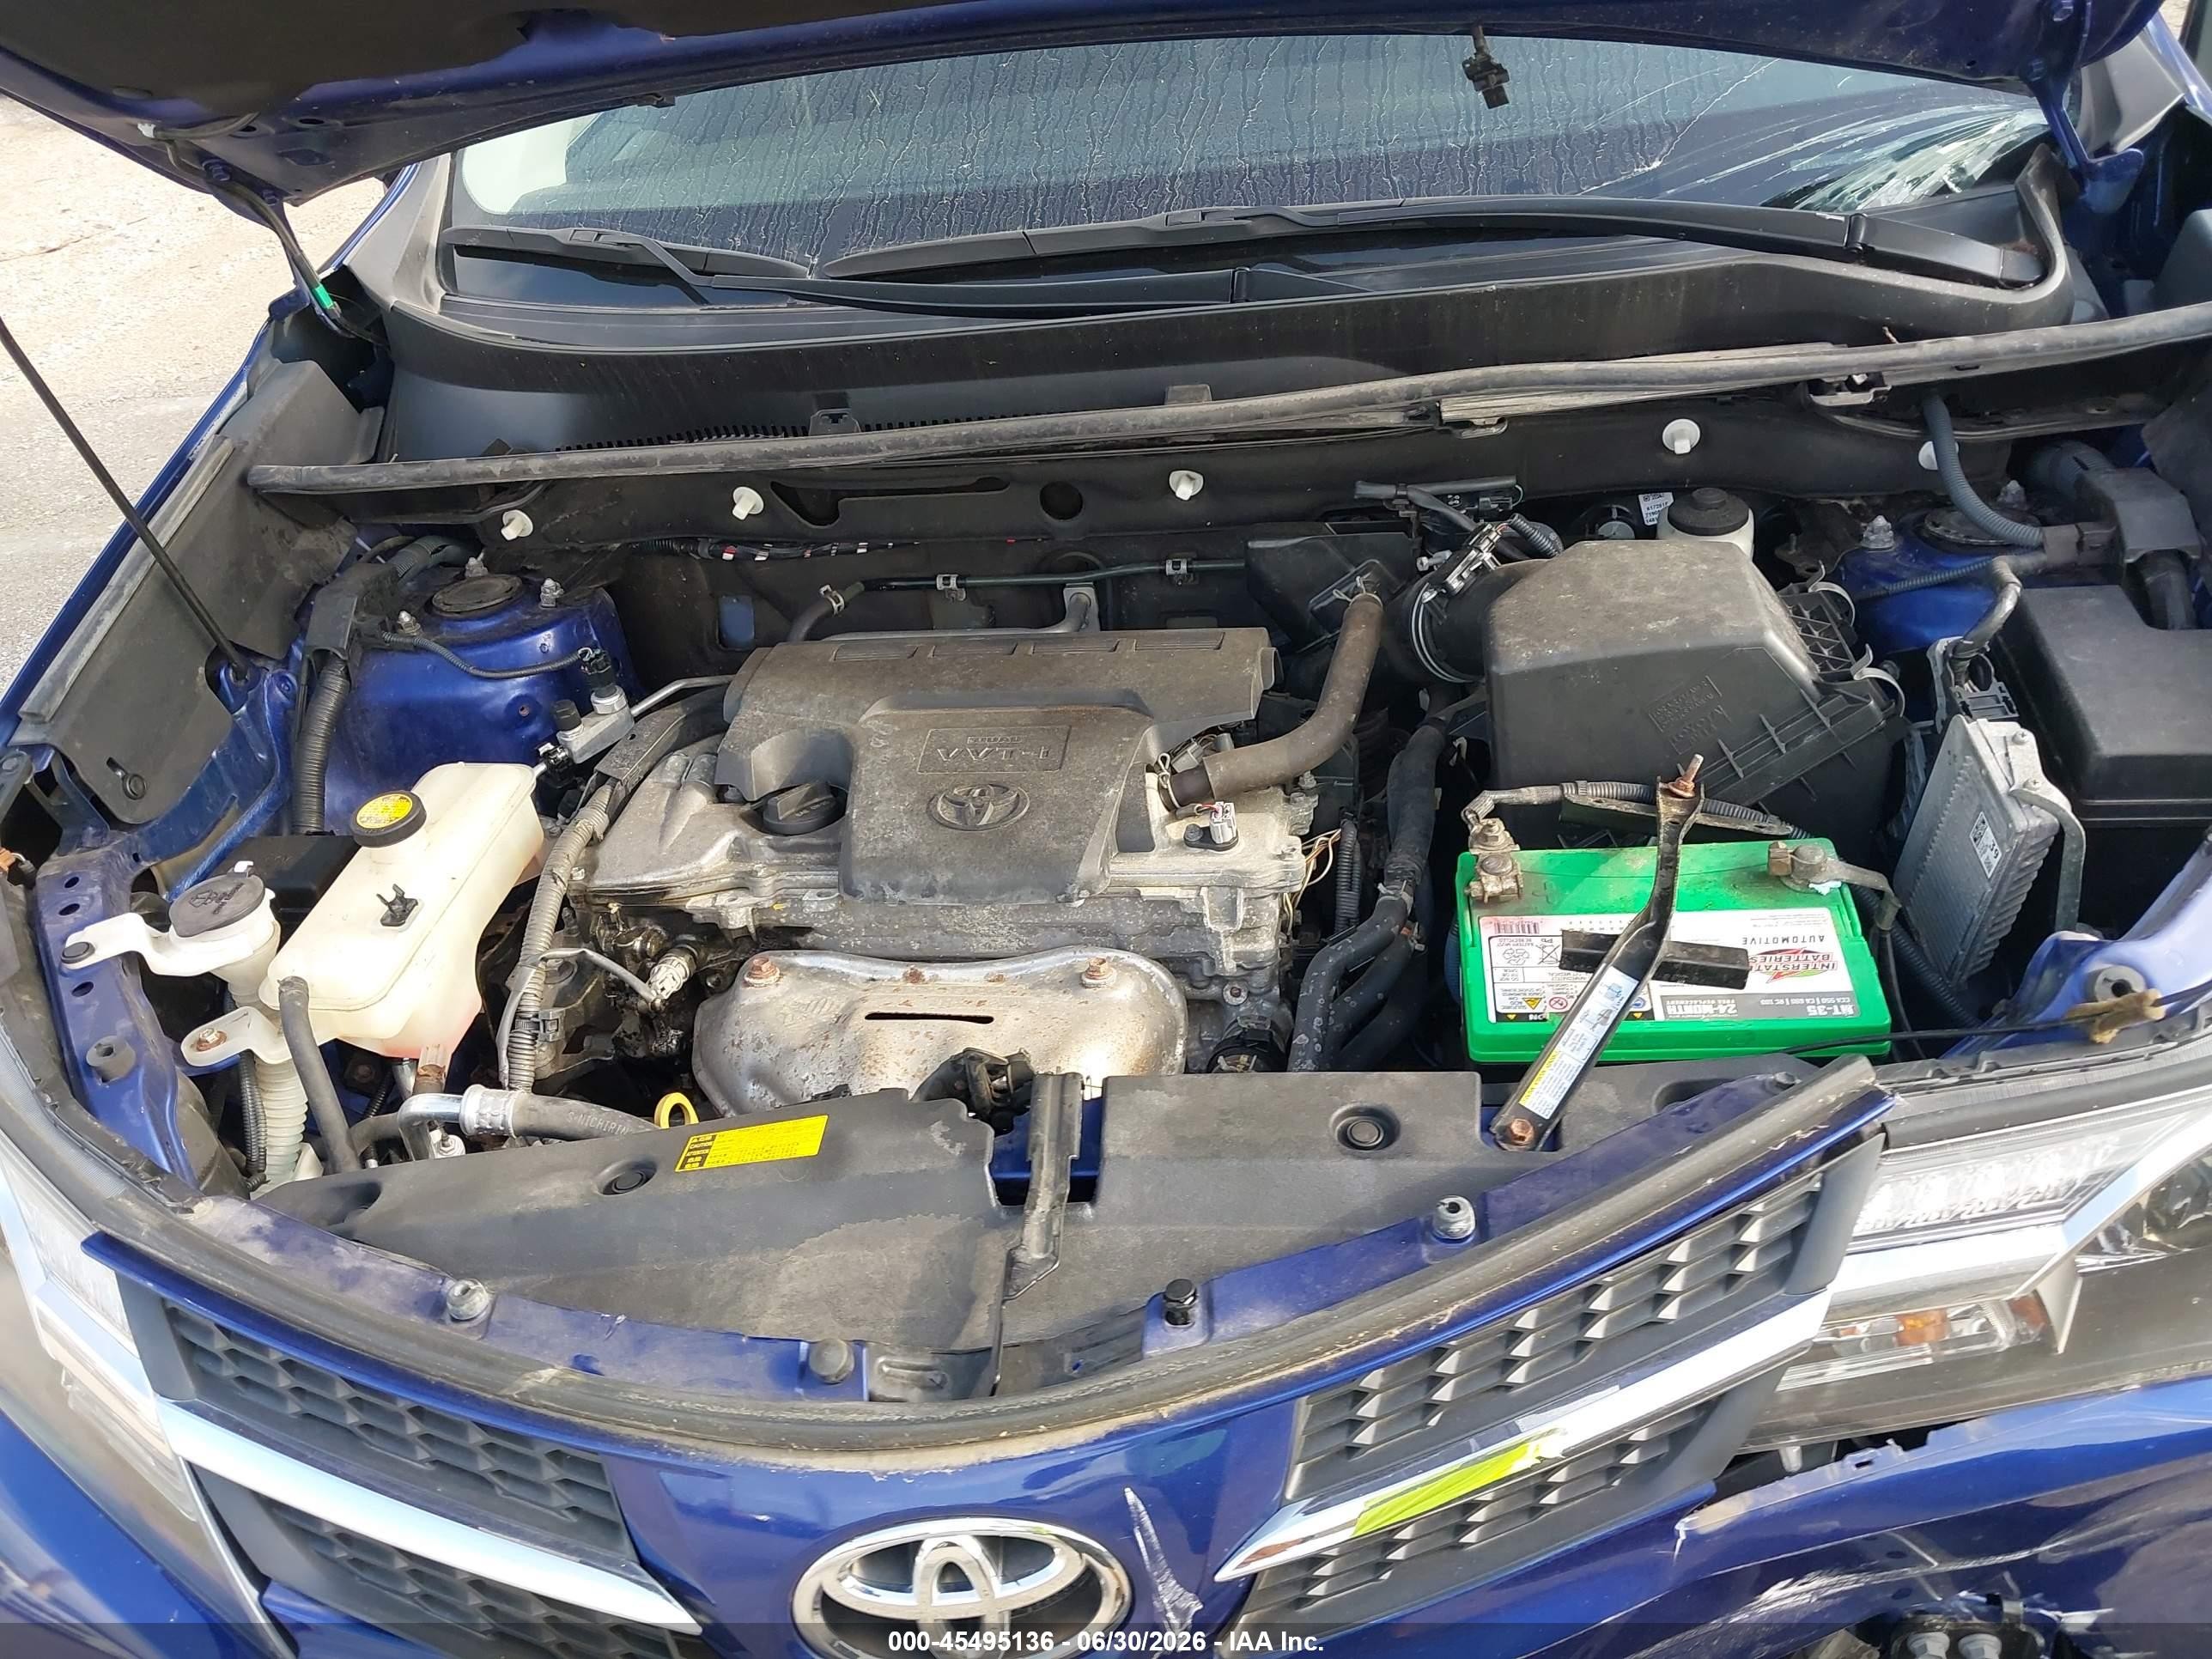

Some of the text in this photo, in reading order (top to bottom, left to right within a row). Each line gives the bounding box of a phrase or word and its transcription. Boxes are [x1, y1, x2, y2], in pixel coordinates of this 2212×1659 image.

[1741, 934, 1826, 945] AUTOMOTIVE
[1748, 953, 1831, 963] BATTERIES
[1749, 962, 1837, 971] INTERSTAT
[1666, 1004, 1738, 1014] 24-MONTH
